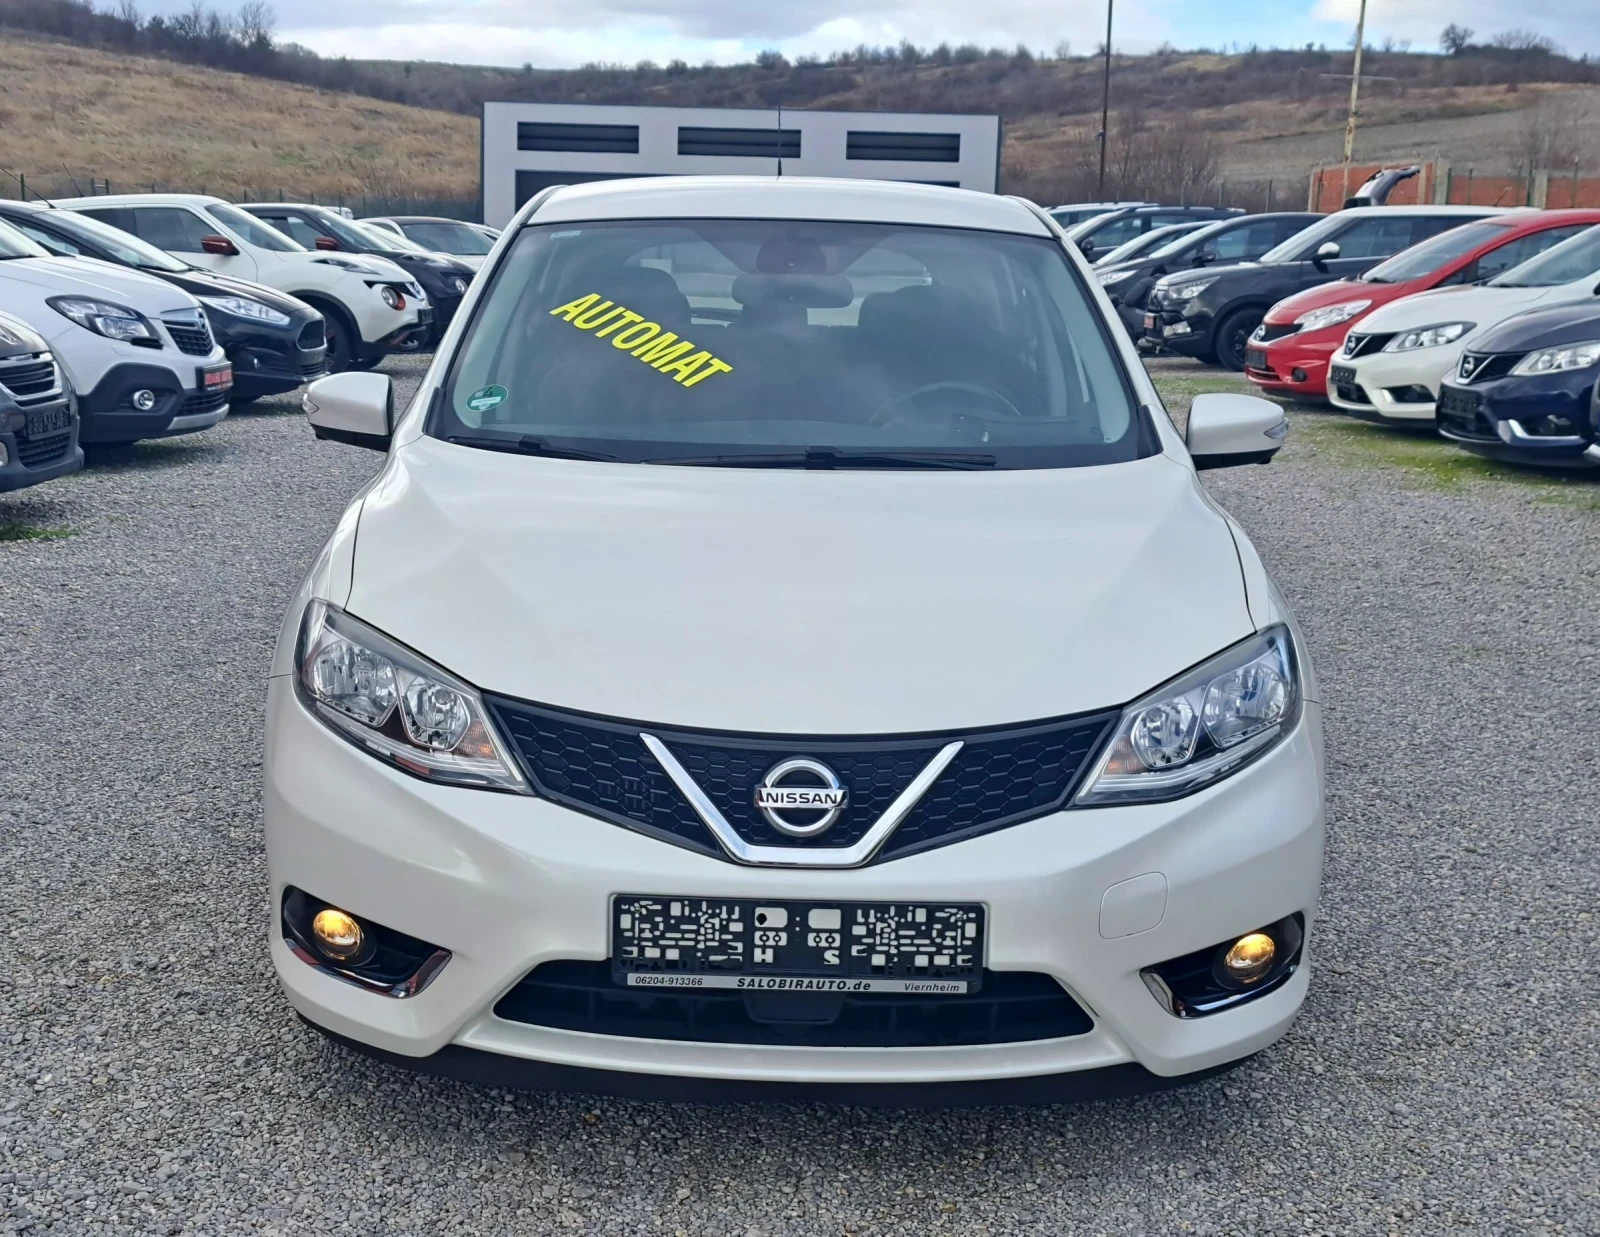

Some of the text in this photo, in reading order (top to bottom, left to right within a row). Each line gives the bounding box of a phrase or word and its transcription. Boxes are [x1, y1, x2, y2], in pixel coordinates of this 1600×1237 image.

[549, 293, 733, 387] AUTOMAT
[766, 792, 837, 804] NISSAN
[635, 976, 960, 992] 06204-913366 SALOBIRAUTO.de Viernheim
